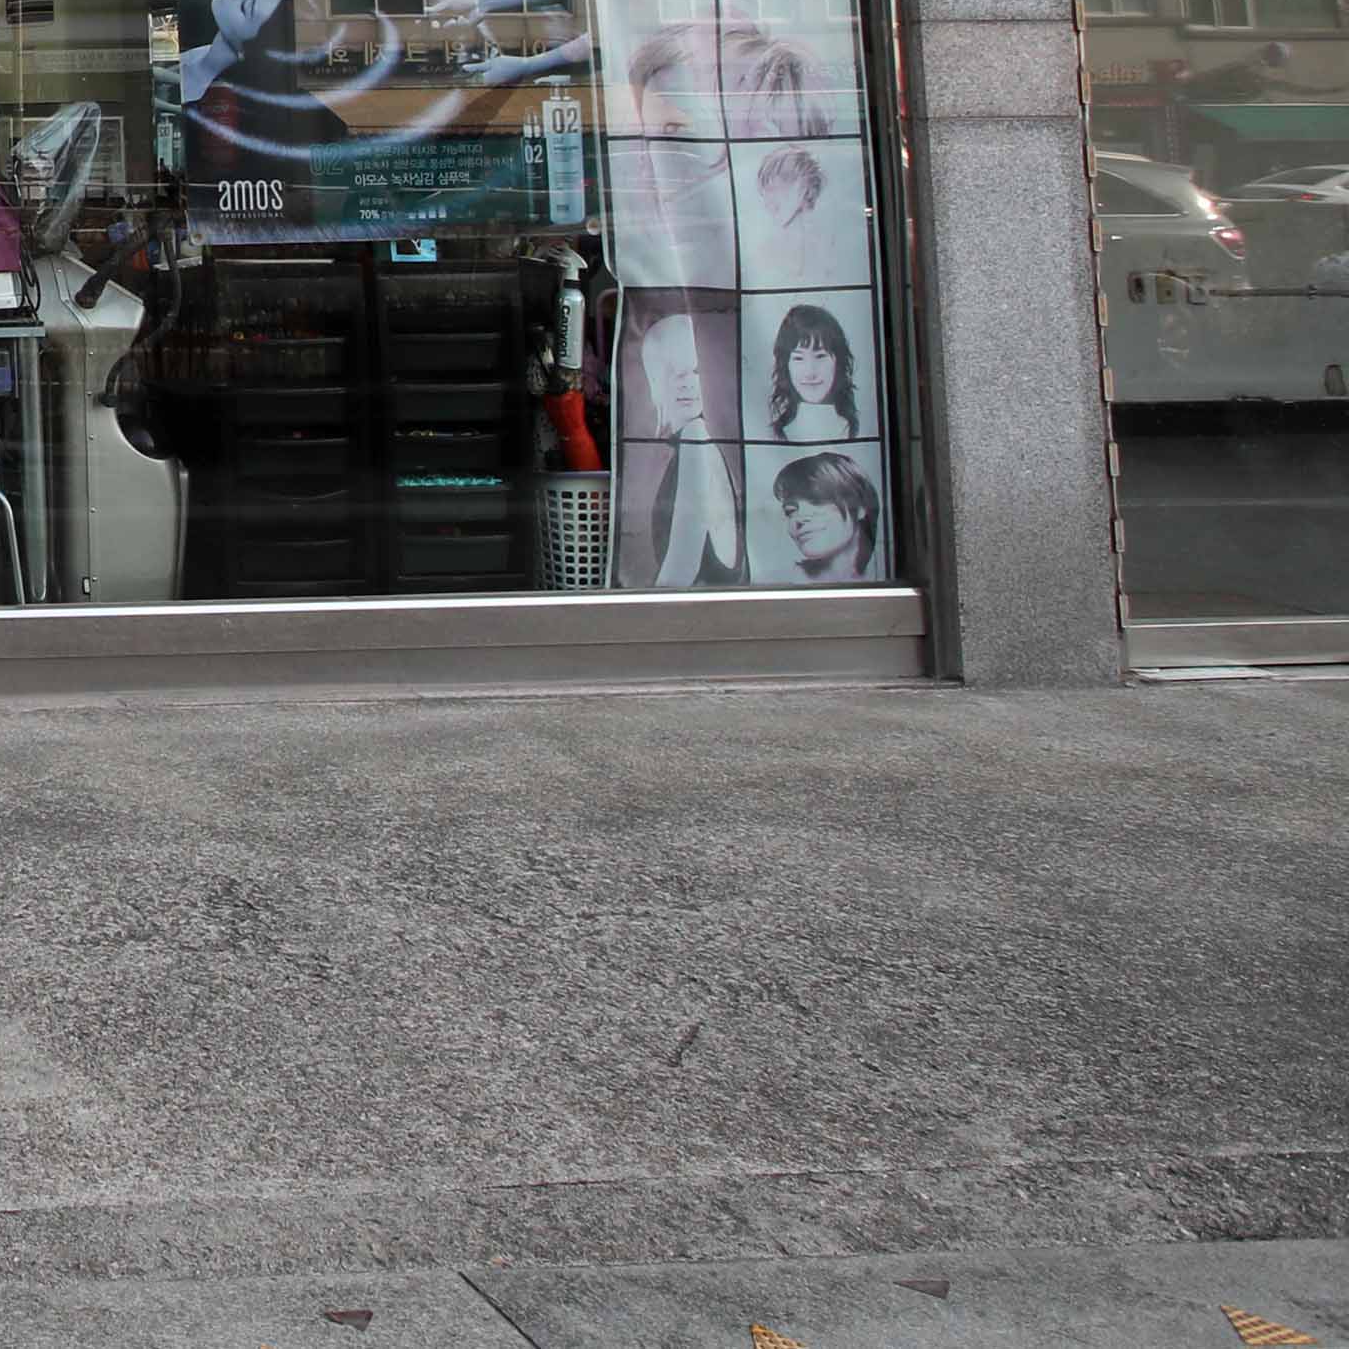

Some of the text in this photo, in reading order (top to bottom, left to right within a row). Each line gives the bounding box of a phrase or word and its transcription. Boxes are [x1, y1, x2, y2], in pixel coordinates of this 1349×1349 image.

[552, 107, 578, 134] 02
[524, 144, 543, 163] 02
[218, 179, 284, 212] amos
[359, 209, 381, 219] 70%
